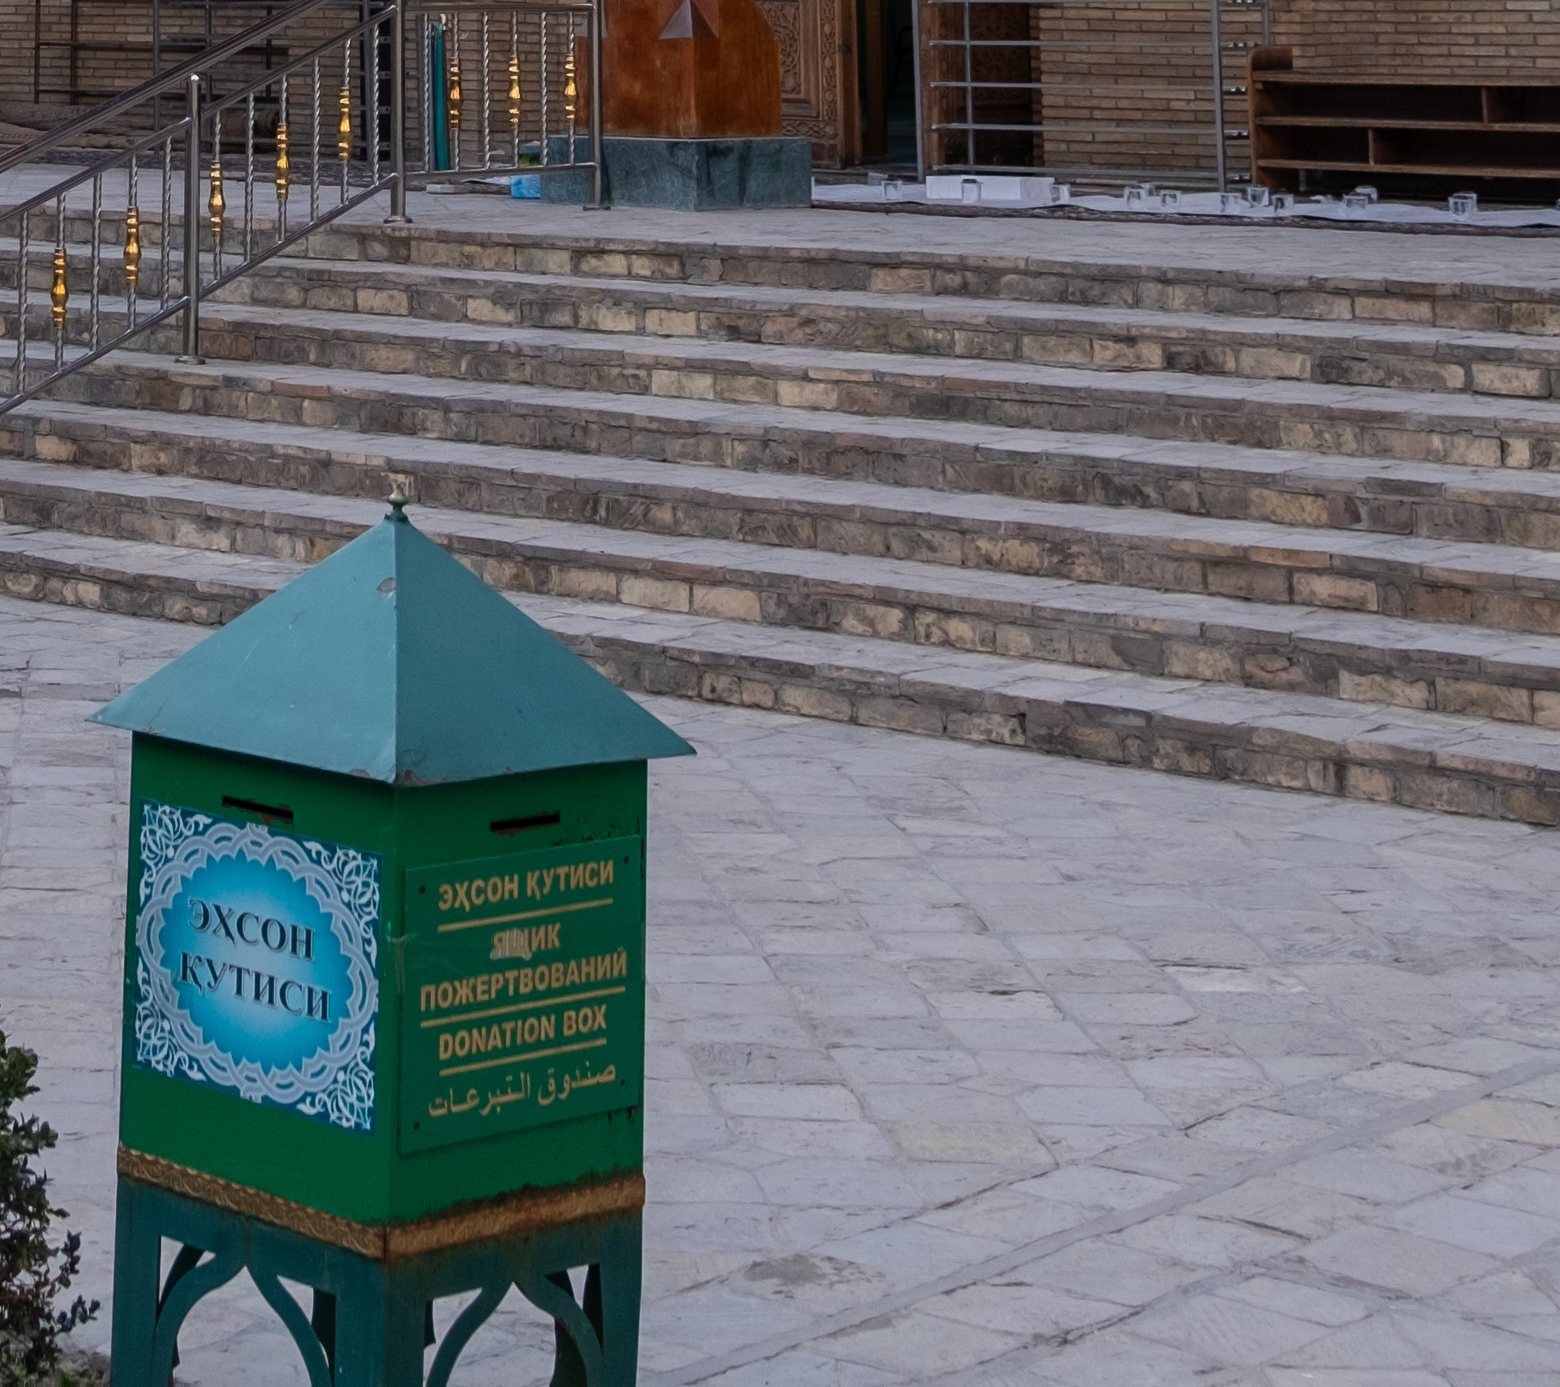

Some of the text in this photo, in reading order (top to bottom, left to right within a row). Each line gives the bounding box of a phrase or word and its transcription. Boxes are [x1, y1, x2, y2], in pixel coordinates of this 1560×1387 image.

[438, 858, 614, 913] ЭҲСОН ҚУТИСИ
[188, 898, 315, 962] ЭҲСОН
[491, 922, 561, 960] ЯЩИК
[179, 951, 332, 1023] ҚУТИСИ
[420, 945, 628, 1012] ПОЖЕРТВОВАНИЙ
[438, 1003, 607, 1061] DONATION BOX
[427, 1060, 616, 1117] صندوق التبرعات
